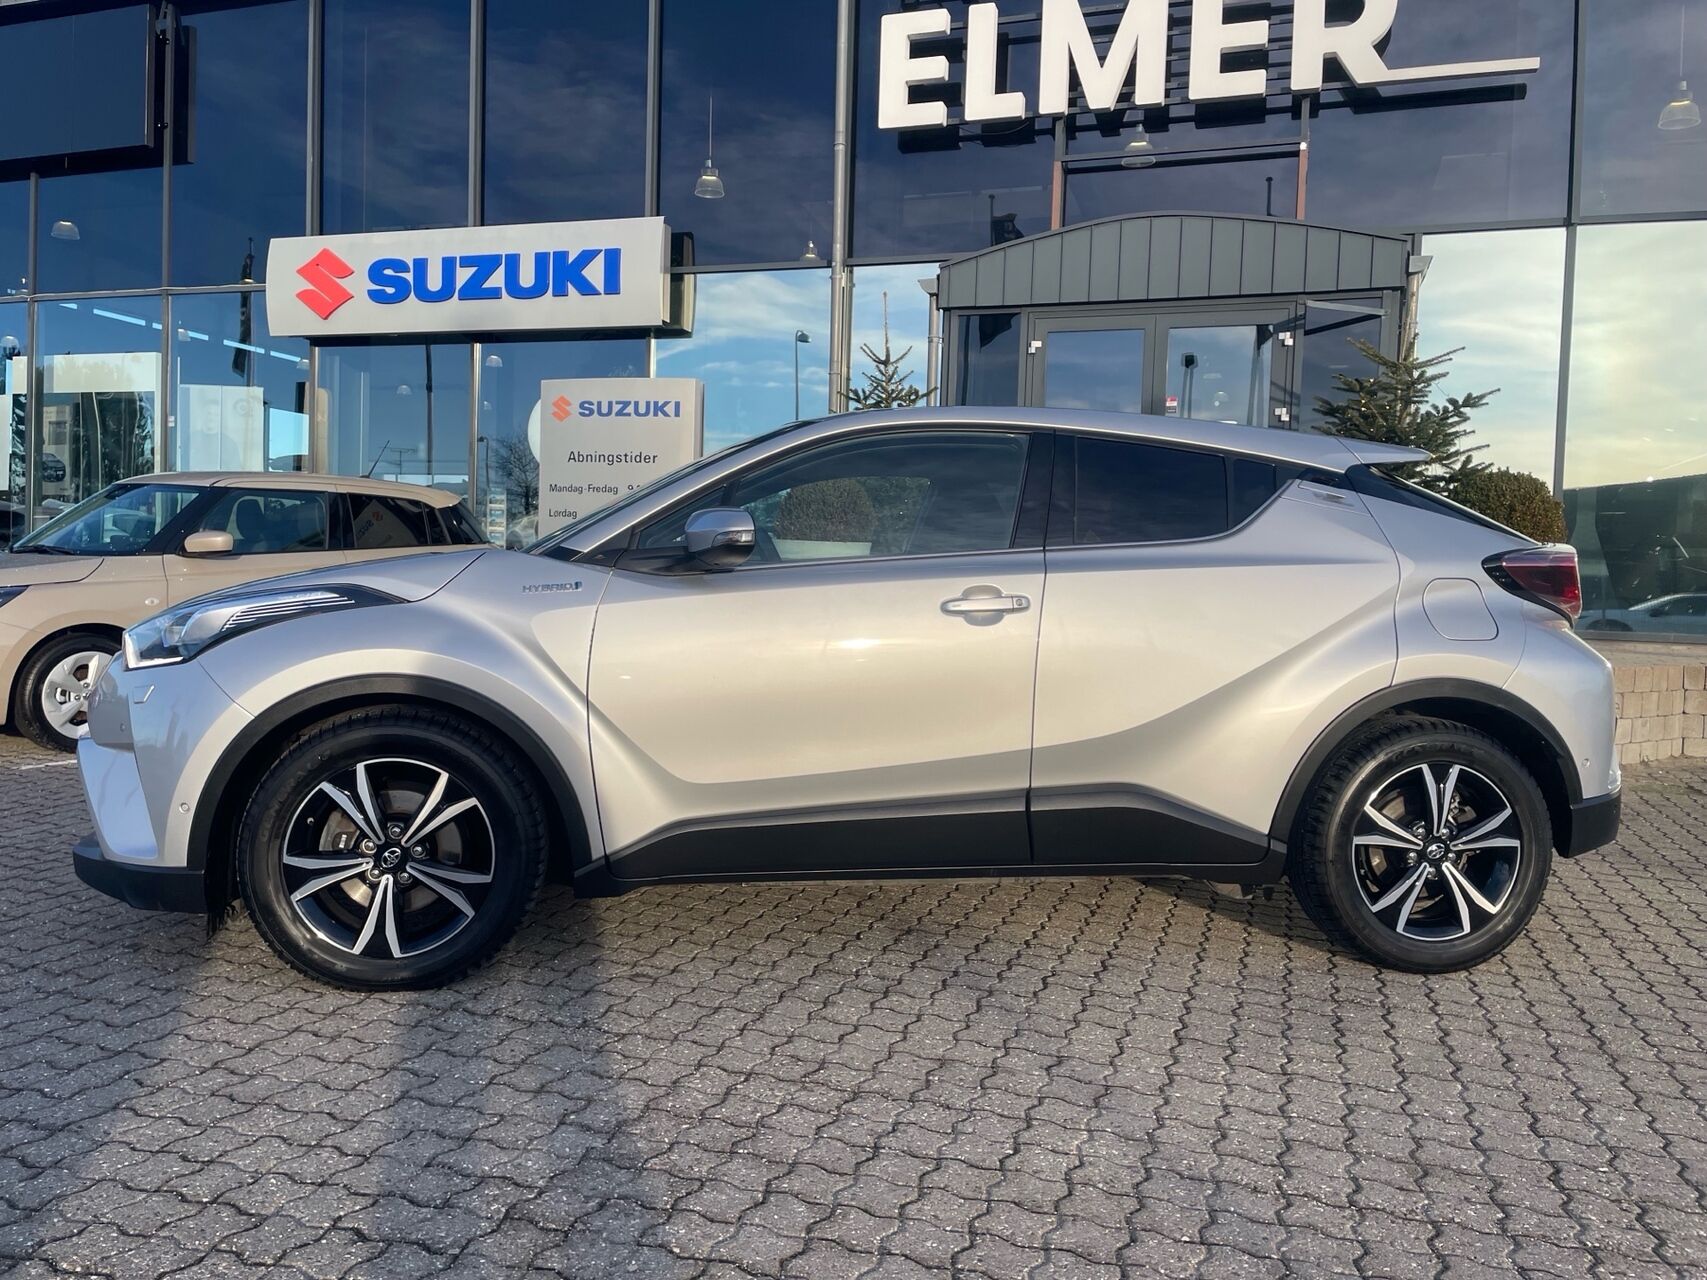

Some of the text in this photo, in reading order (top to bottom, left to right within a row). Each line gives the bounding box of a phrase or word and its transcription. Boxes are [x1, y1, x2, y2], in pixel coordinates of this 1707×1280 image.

[878, 0, 1540, 129] ELMER
[367, 247, 622, 304] SUZUKI
[578, 400, 681, 418] SUZUKI
[522, 582, 573, 593] HYBRID
